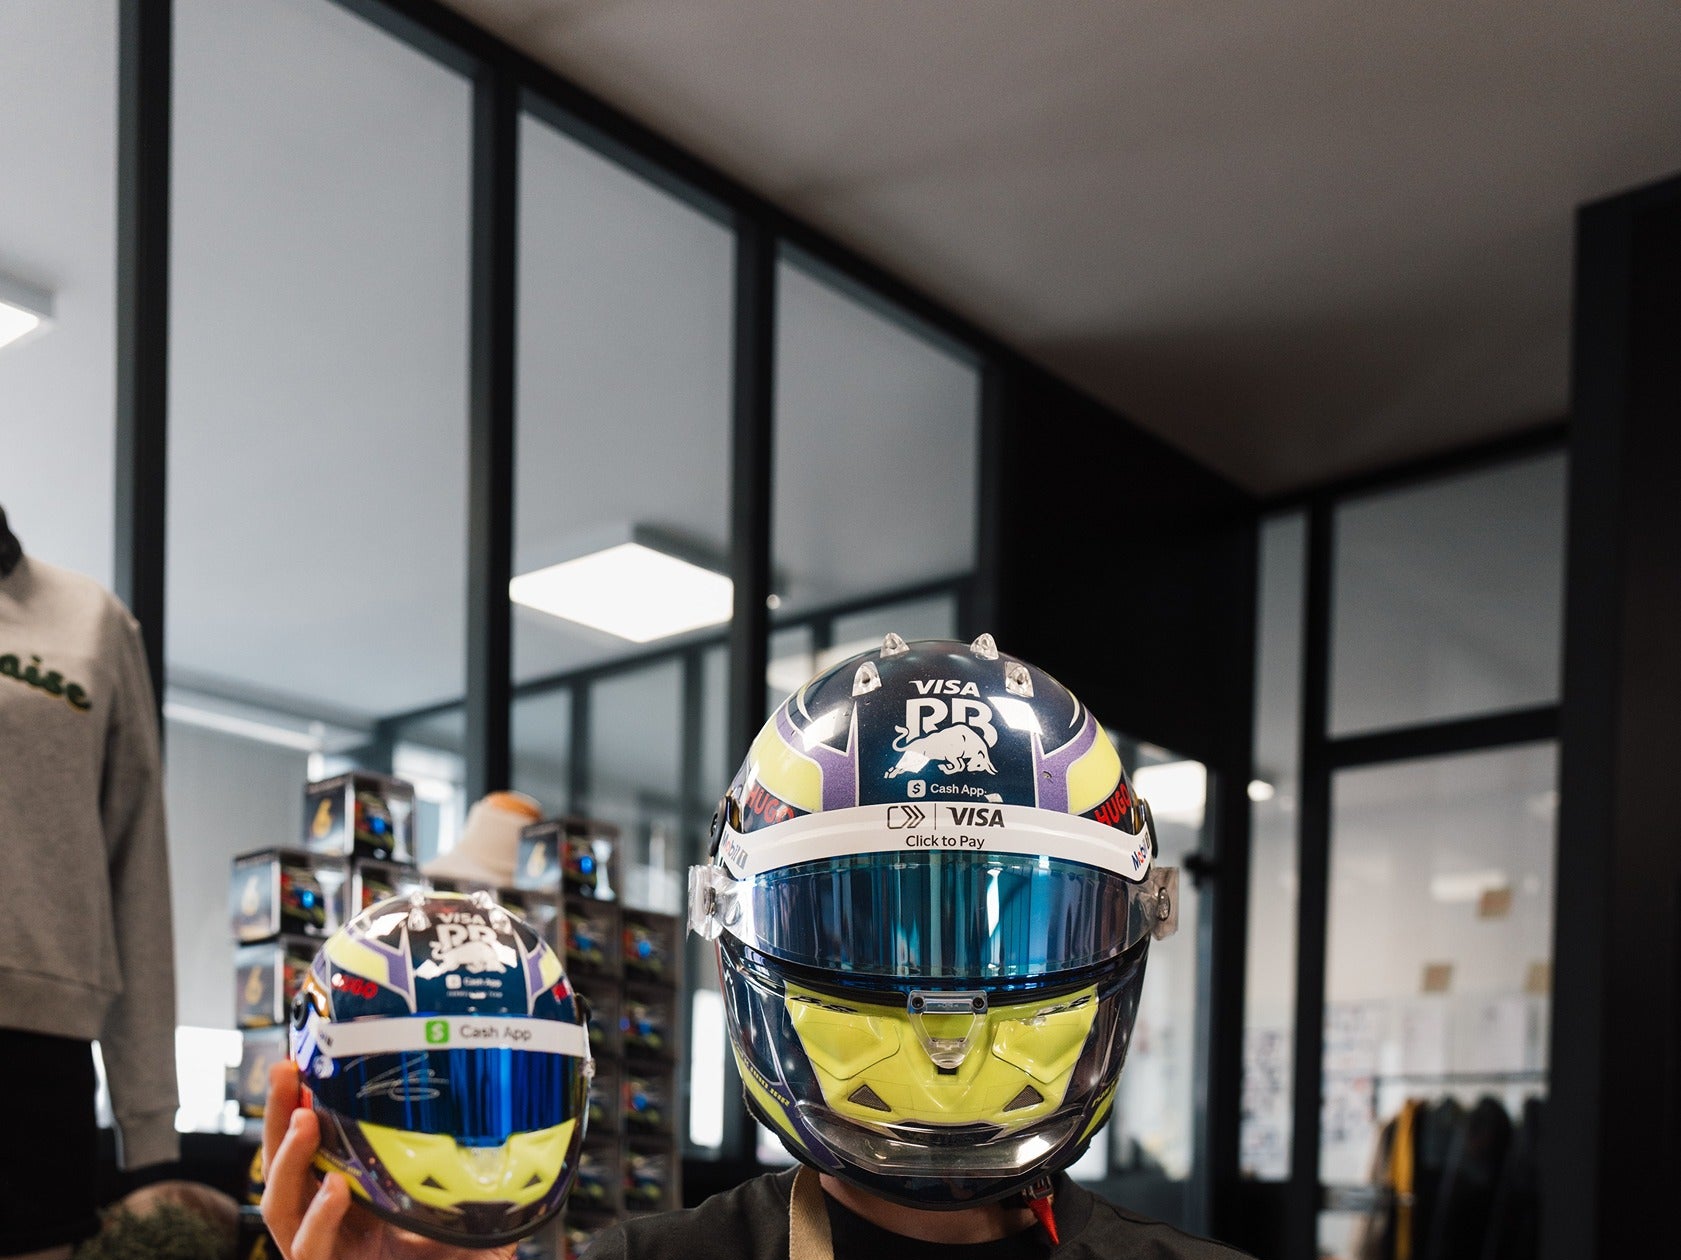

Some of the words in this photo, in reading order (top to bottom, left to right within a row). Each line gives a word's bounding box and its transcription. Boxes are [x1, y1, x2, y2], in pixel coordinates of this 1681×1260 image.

[909, 679, 980, 697] VISA
[906, 697, 998, 748] RB
[930, 783, 959, 794] Cash
[746, 783, 795, 823] HUGO
[946, 806, 1005, 828] VISA
[905, 835, 939, 848] Click
[942, 837, 957, 848] to
[960, 835, 986, 849] Pay
[460, 1024, 499, 1039] Cash
[504, 1025, 532, 1041] App
